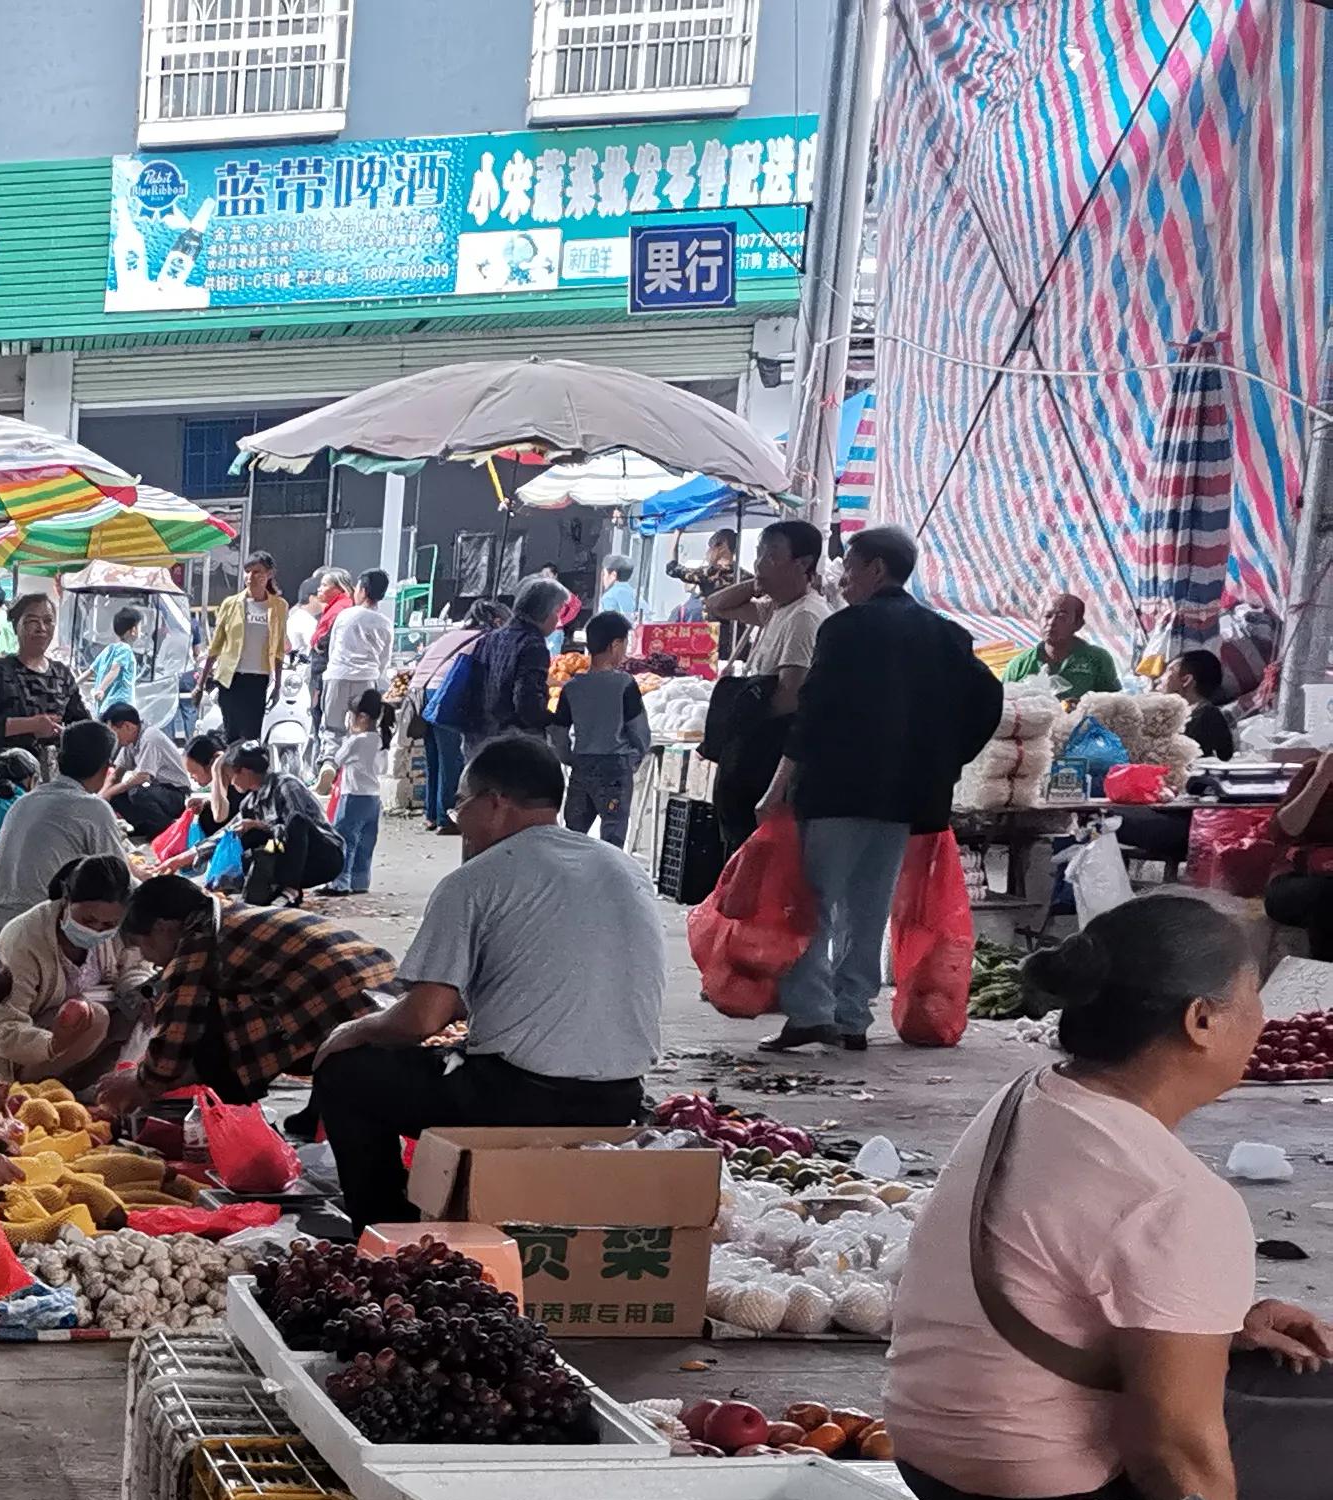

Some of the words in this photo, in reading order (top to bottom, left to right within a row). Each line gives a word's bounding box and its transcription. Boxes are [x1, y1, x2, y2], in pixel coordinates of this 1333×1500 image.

[215, 151, 452, 219] 蓝带啤酒
[644, 237, 724, 295] 果行
